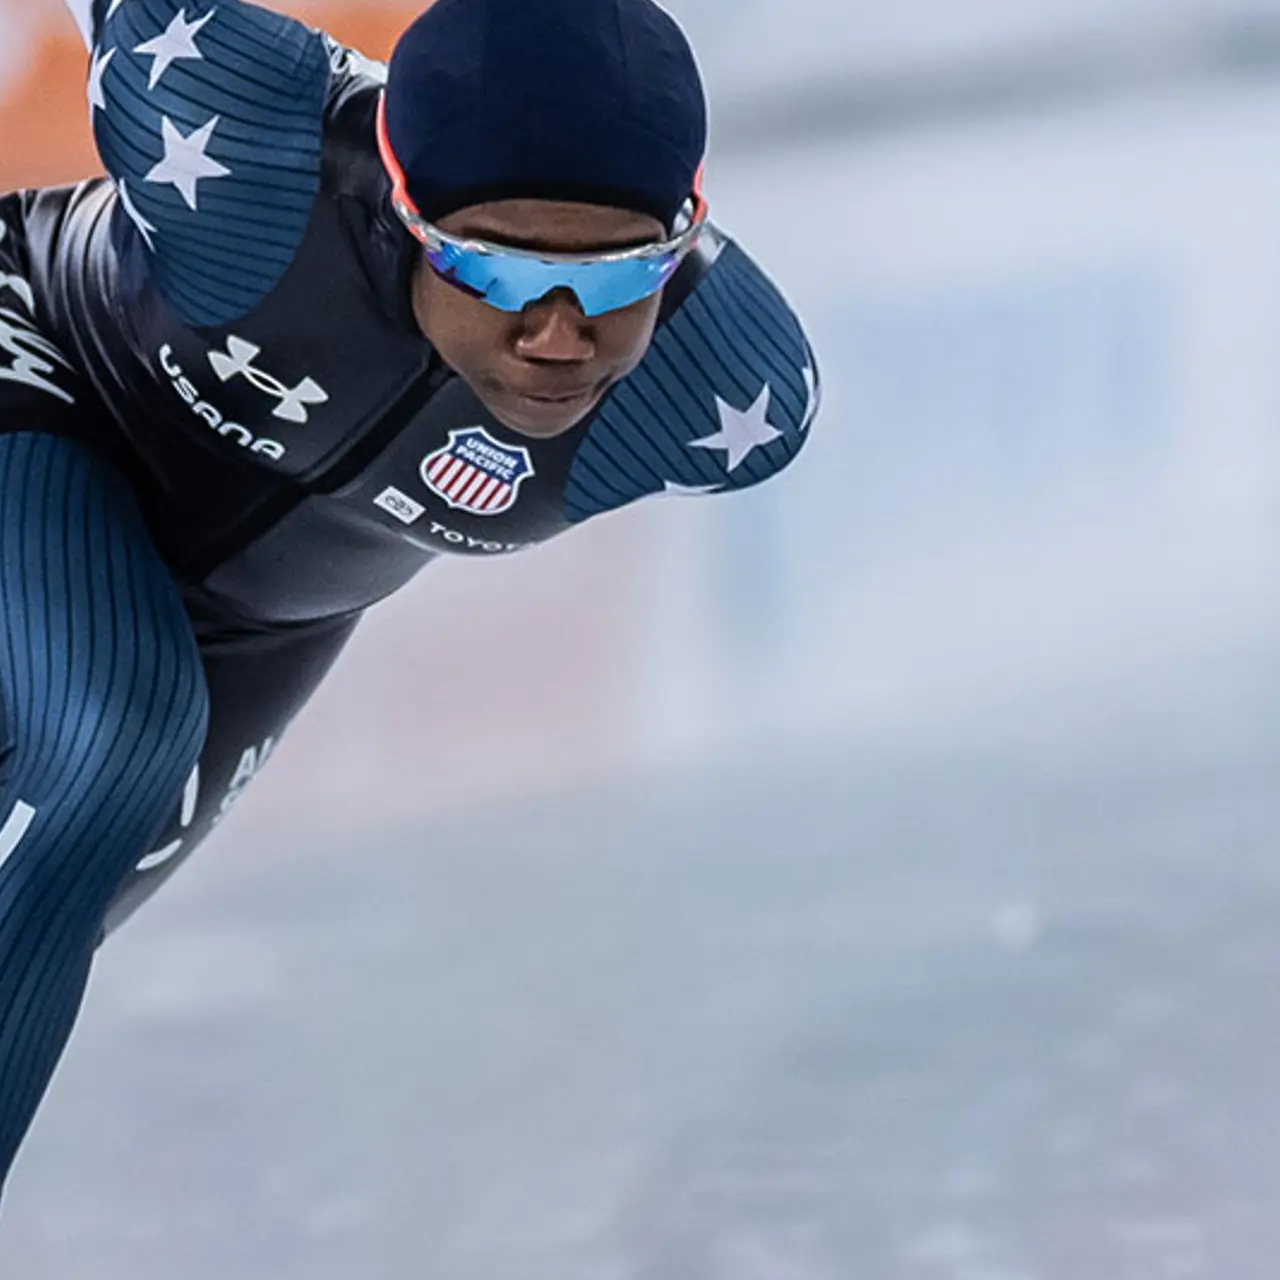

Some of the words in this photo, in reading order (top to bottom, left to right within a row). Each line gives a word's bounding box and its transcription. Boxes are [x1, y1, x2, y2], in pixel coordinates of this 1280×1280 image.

[159, 342, 286, 460] USANA
[455, 444, 516, 480] PACIFIC
[466, 437, 518, 469] UNION
[429, 521, 536, 552] TOYO
